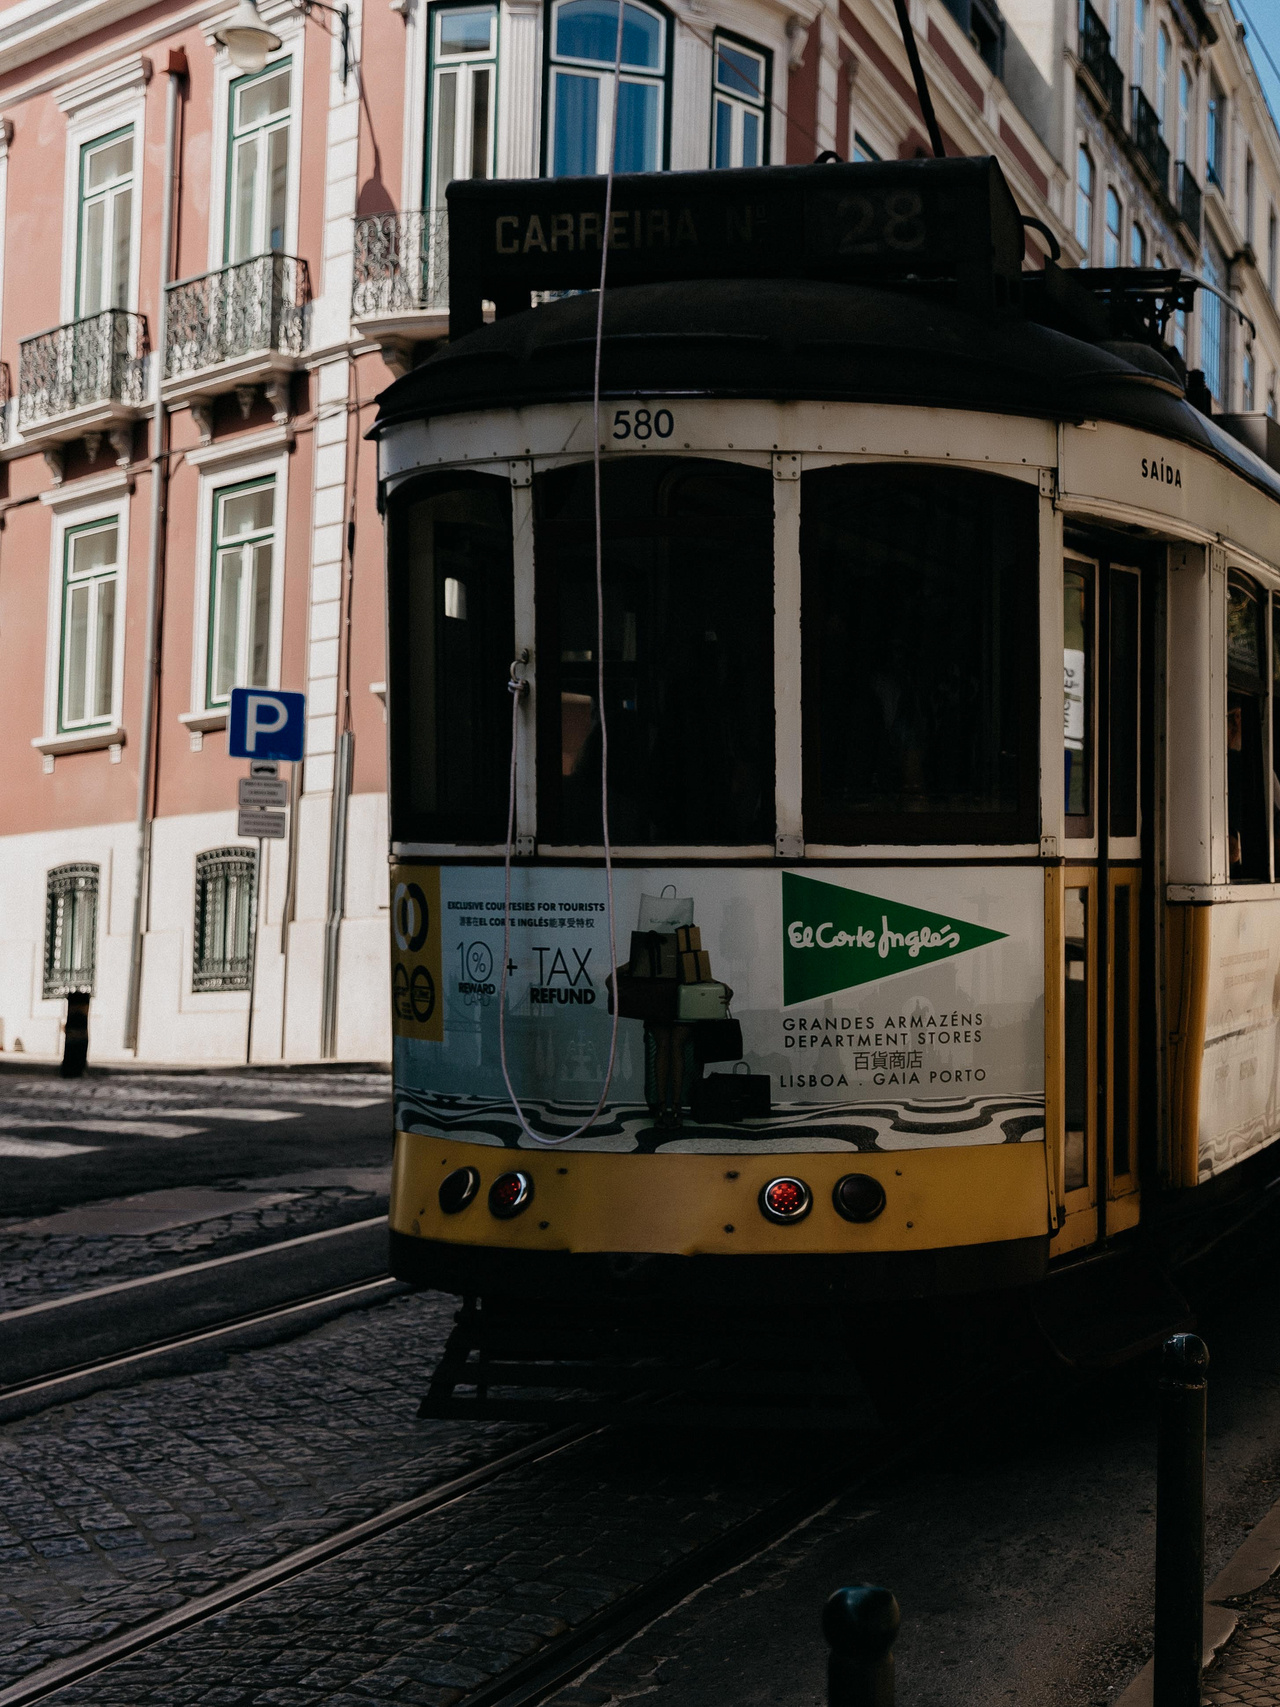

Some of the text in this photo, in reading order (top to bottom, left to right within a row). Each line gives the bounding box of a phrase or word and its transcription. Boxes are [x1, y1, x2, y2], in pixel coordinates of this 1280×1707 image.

[495, 209, 699, 254] CARREIRA
[837, 190, 926, 254] 28
[612, 408, 674, 440] 580
[1141, 456, 1182, 488] SAÍDA
[245, 695, 289, 752] P
[447, 901, 484, 910] EXCLUSIVE
[537, 902, 556, 911] FOR
[558, 903, 605, 912] TOURISTS
[517, 916, 549, 928] INGLÉS
[787, 915, 961, 958] El Corte Inglés
[532, 947, 594, 987] TAX
[458, 982, 496, 995] REWARD
[530, 987, 596, 1005] REFUND
[782, 1011, 984, 1031] GRANDES ARMAZÉNS
[784, 1030, 983, 1048] DEPARTMENT STORES
[853, 1050, 923, 1071] 百貨商店
[780, 1068, 987, 1088] LISBOA GAIA PORTO
